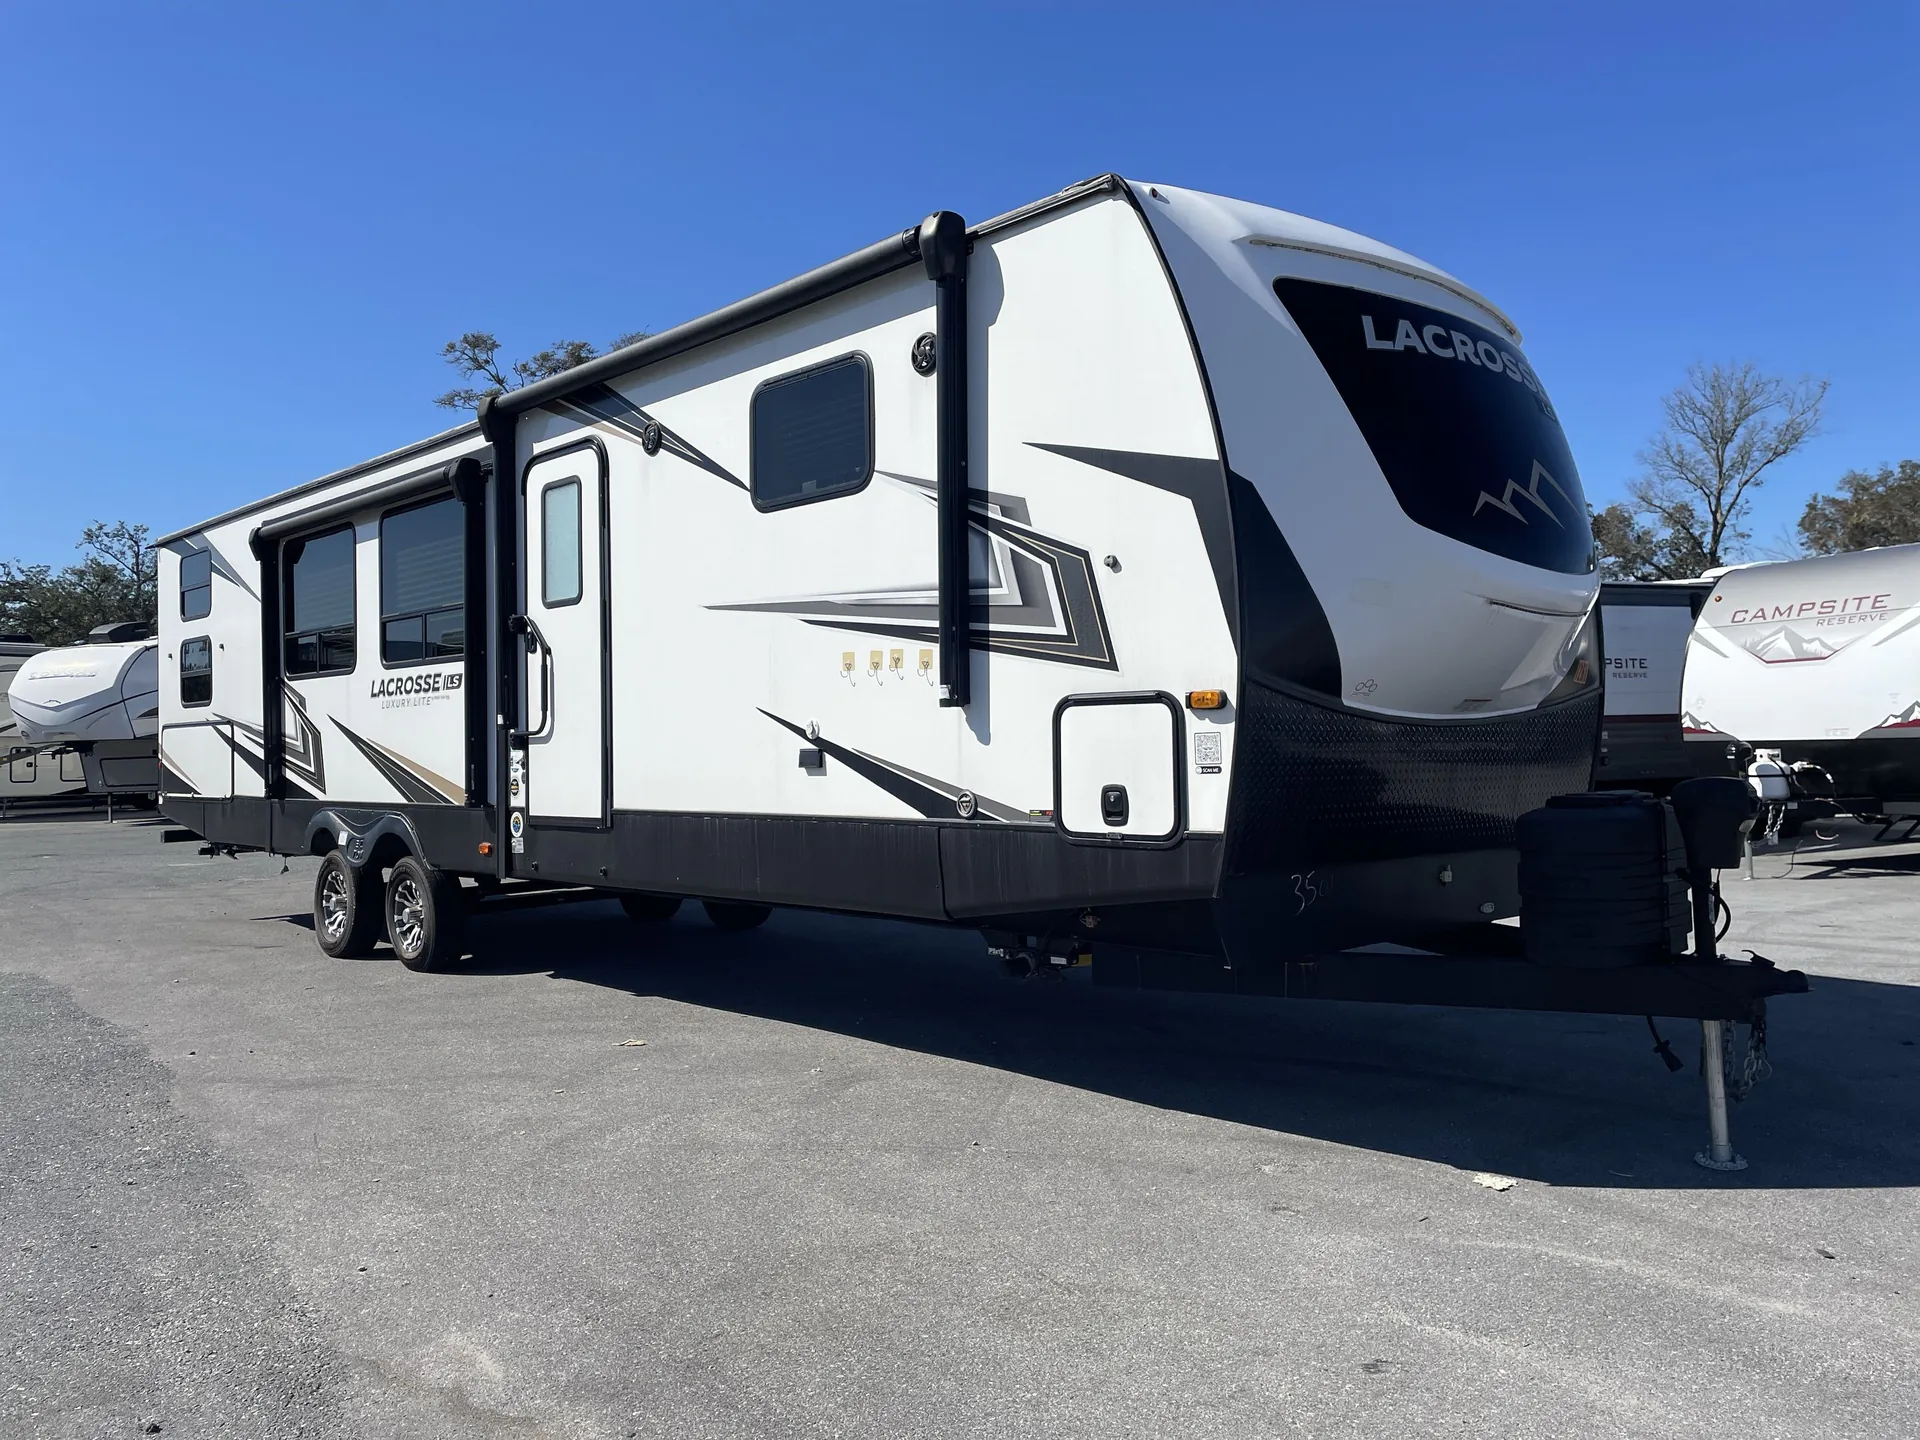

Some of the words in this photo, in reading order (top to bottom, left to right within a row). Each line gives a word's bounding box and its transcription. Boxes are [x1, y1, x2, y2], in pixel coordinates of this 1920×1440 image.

[1730, 593, 1892, 624] CAMPSITE
[1815, 612, 1889, 627] RESERVE
[370, 673, 441, 698] LACROSSE
[381, 698, 411, 709] LUXURY
[413, 696, 432, 707] LITE
